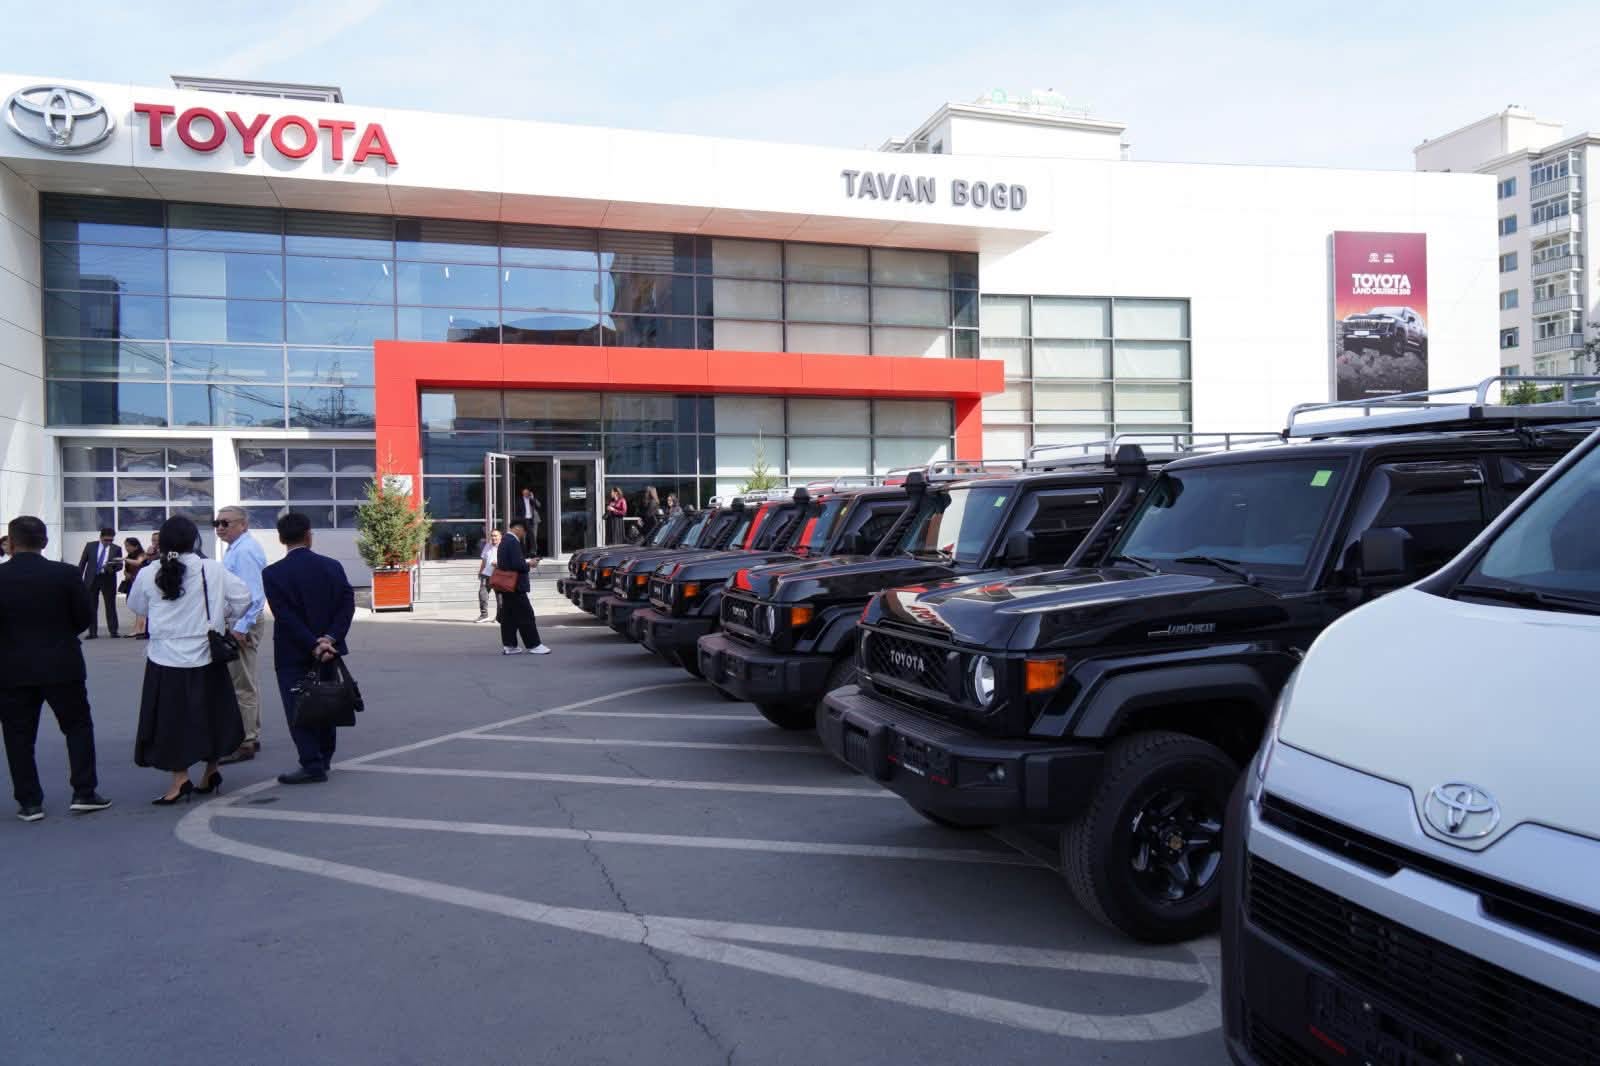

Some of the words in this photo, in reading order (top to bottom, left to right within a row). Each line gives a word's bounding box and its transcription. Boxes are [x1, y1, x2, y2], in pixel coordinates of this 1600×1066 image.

[134, 102, 398, 166] TOYOTA
[841, 169, 936, 204] TAVAN
[952, 178, 1028, 211] BOGD
[1351, 273, 1411, 289] TOYOTA
[890, 649, 925, 672] TOYOTA
